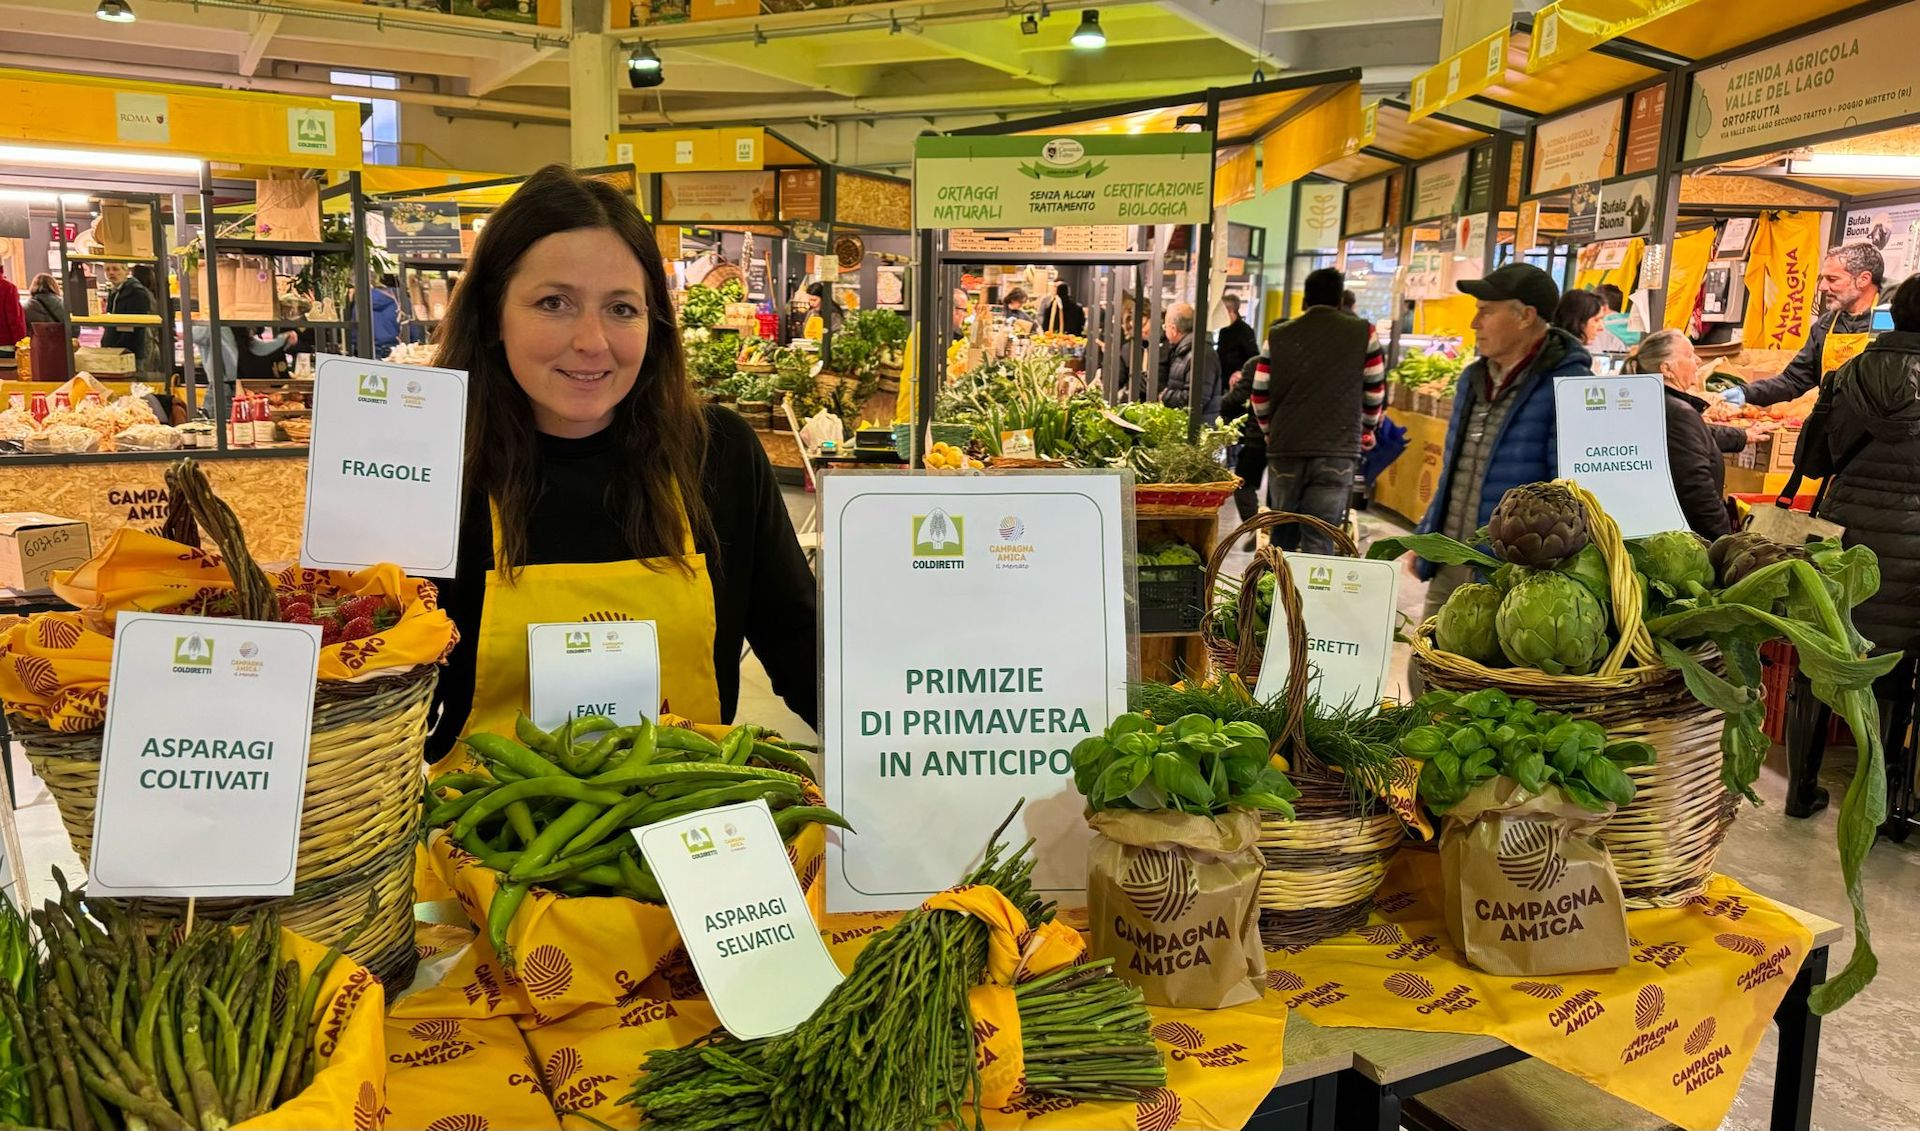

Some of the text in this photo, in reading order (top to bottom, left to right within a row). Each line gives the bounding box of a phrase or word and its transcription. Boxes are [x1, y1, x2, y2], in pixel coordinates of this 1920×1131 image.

[1727, 38, 1860, 92] AZIENDA AGRICOLA
[1725, 67, 1835, 112] VALLE DEL LAGO
[120, 113, 150, 123] ROMA
[1721, 130, 1729, 139] VIA
[1731, 128, 1746, 137] VALLE
[1747, 125, 1757, 134] DEL
[1758, 122, 1773, 131] LAGO
[1774, 113, 1801, 127] SECONDO
[1803, 109, 1827, 121] TRATTO
[1838, 100, 1863, 113] POGGIO
[1865, 92, 1896, 107] MIRTETO
[1897, 86, 1912, 100] (RI)
[1722, 104, 1780, 128] ORTOFRUTTA
[937, 185, 999, 201] ORTAGGI
[1030, 190, 1095, 200] SENZA ALCUN
[1104, 182, 1204, 199] CERTIFICAZIONE
[934, 204, 1002, 221] NATURALI
[1029, 202, 1096, 213] TRATTAMENTO
[1118, 201, 1188, 217] BIOLOGICA
[1601, 199, 1626, 215] Bufala
[1600, 216, 1624, 230] Buona
[1846, 226, 1869, 236] Buona
[1847, 214, 1871, 226] Bufala
[1585, 445, 1638, 458] CARCIOFI
[342, 459, 432, 482] FRAGOLE
[1574, 460, 1652, 473] ROMANESCHI
[108, 489, 167, 505] CAMPA
[989, 545, 1034, 553] CAMPAGNA
[997, 553, 1027, 561] AMICA
[912, 560, 964, 570] COLDIRETTI
[1307, 638, 1359, 656] GRETTI
[172, 665, 212, 675] COLDIRETTI
[906, 667, 1043, 694] PRIMIZIE
[577, 703, 617, 718] FAVE
[861, 707, 1091, 736] DI PRIMAVERA
[141, 738, 274, 760] ASPARAGI
[880, 748, 1072, 777] IN ANTICIPO
[139, 769, 270, 790] COLTIVATI
[1474, 885, 1605, 921] CAMPAGNA
[704, 897, 788, 933] ASPARAGI
[716, 923, 796, 958] SELVATICI
[1114, 915, 1231, 955] CAMPAGNA
[1500, 917, 1585, 942] AMICA
[1129, 944, 1212, 976] AMICA
[1736, 945, 1792, 987] CAMPAGNA
[1743, 965, 1784, 993] AMICA
[1548, 988, 1602, 1027] CAMPAGNA
[1565, 1000, 1605, 1036] AMICA
[1624, 1036, 1667, 1065] AMICA
[1672, 1044, 1732, 1087] CAMPAGNA
[1685, 1063, 1724, 1095] AMICA
